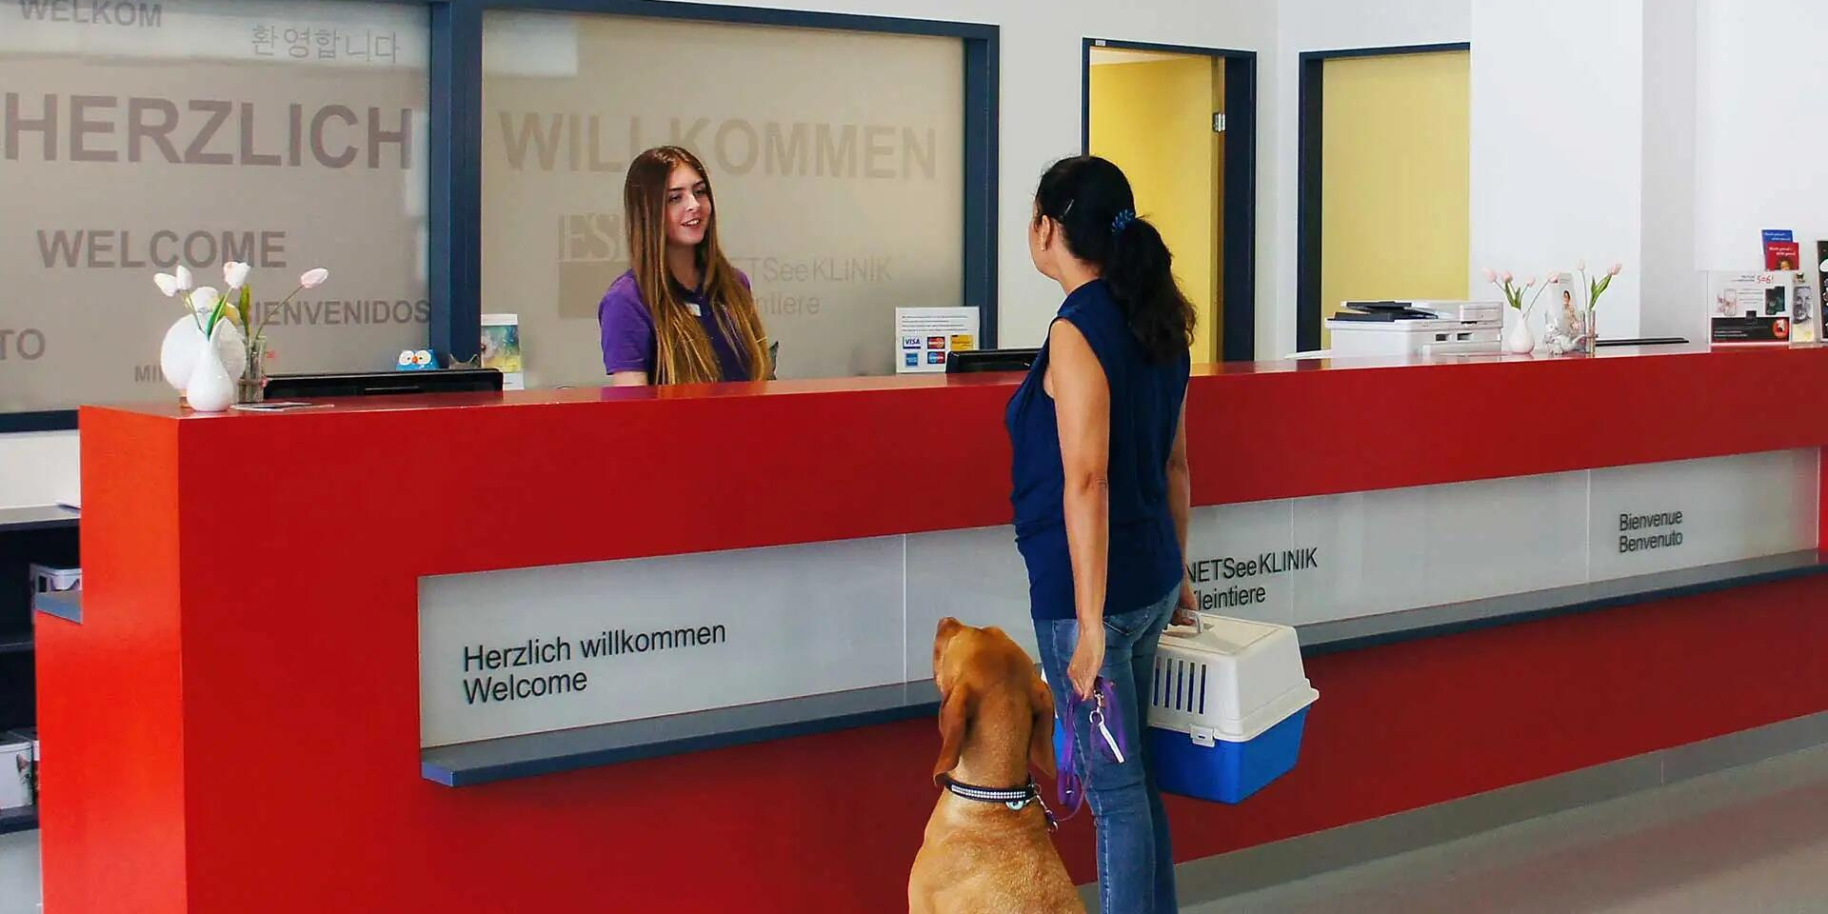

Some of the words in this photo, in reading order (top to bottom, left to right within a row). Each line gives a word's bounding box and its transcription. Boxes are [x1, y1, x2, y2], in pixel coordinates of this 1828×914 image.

[18, 0, 162, 28] WELKOM
[252, 23, 401, 64] 환영합니다
[4, 92, 412, 170] HERZLICH
[37, 229, 288, 269] WELCOME
[252, 300, 430, 326] IENVENIDOS
[1619, 510, 1683, 532] Bienvenue
[1619, 530, 1684, 553] Benvenuto
[1194, 585, 1266, 611] leintiere
[463, 637, 571, 672] Herzlich
[580, 624, 726, 659] willkommen
[463, 671, 587, 704] Welcome
